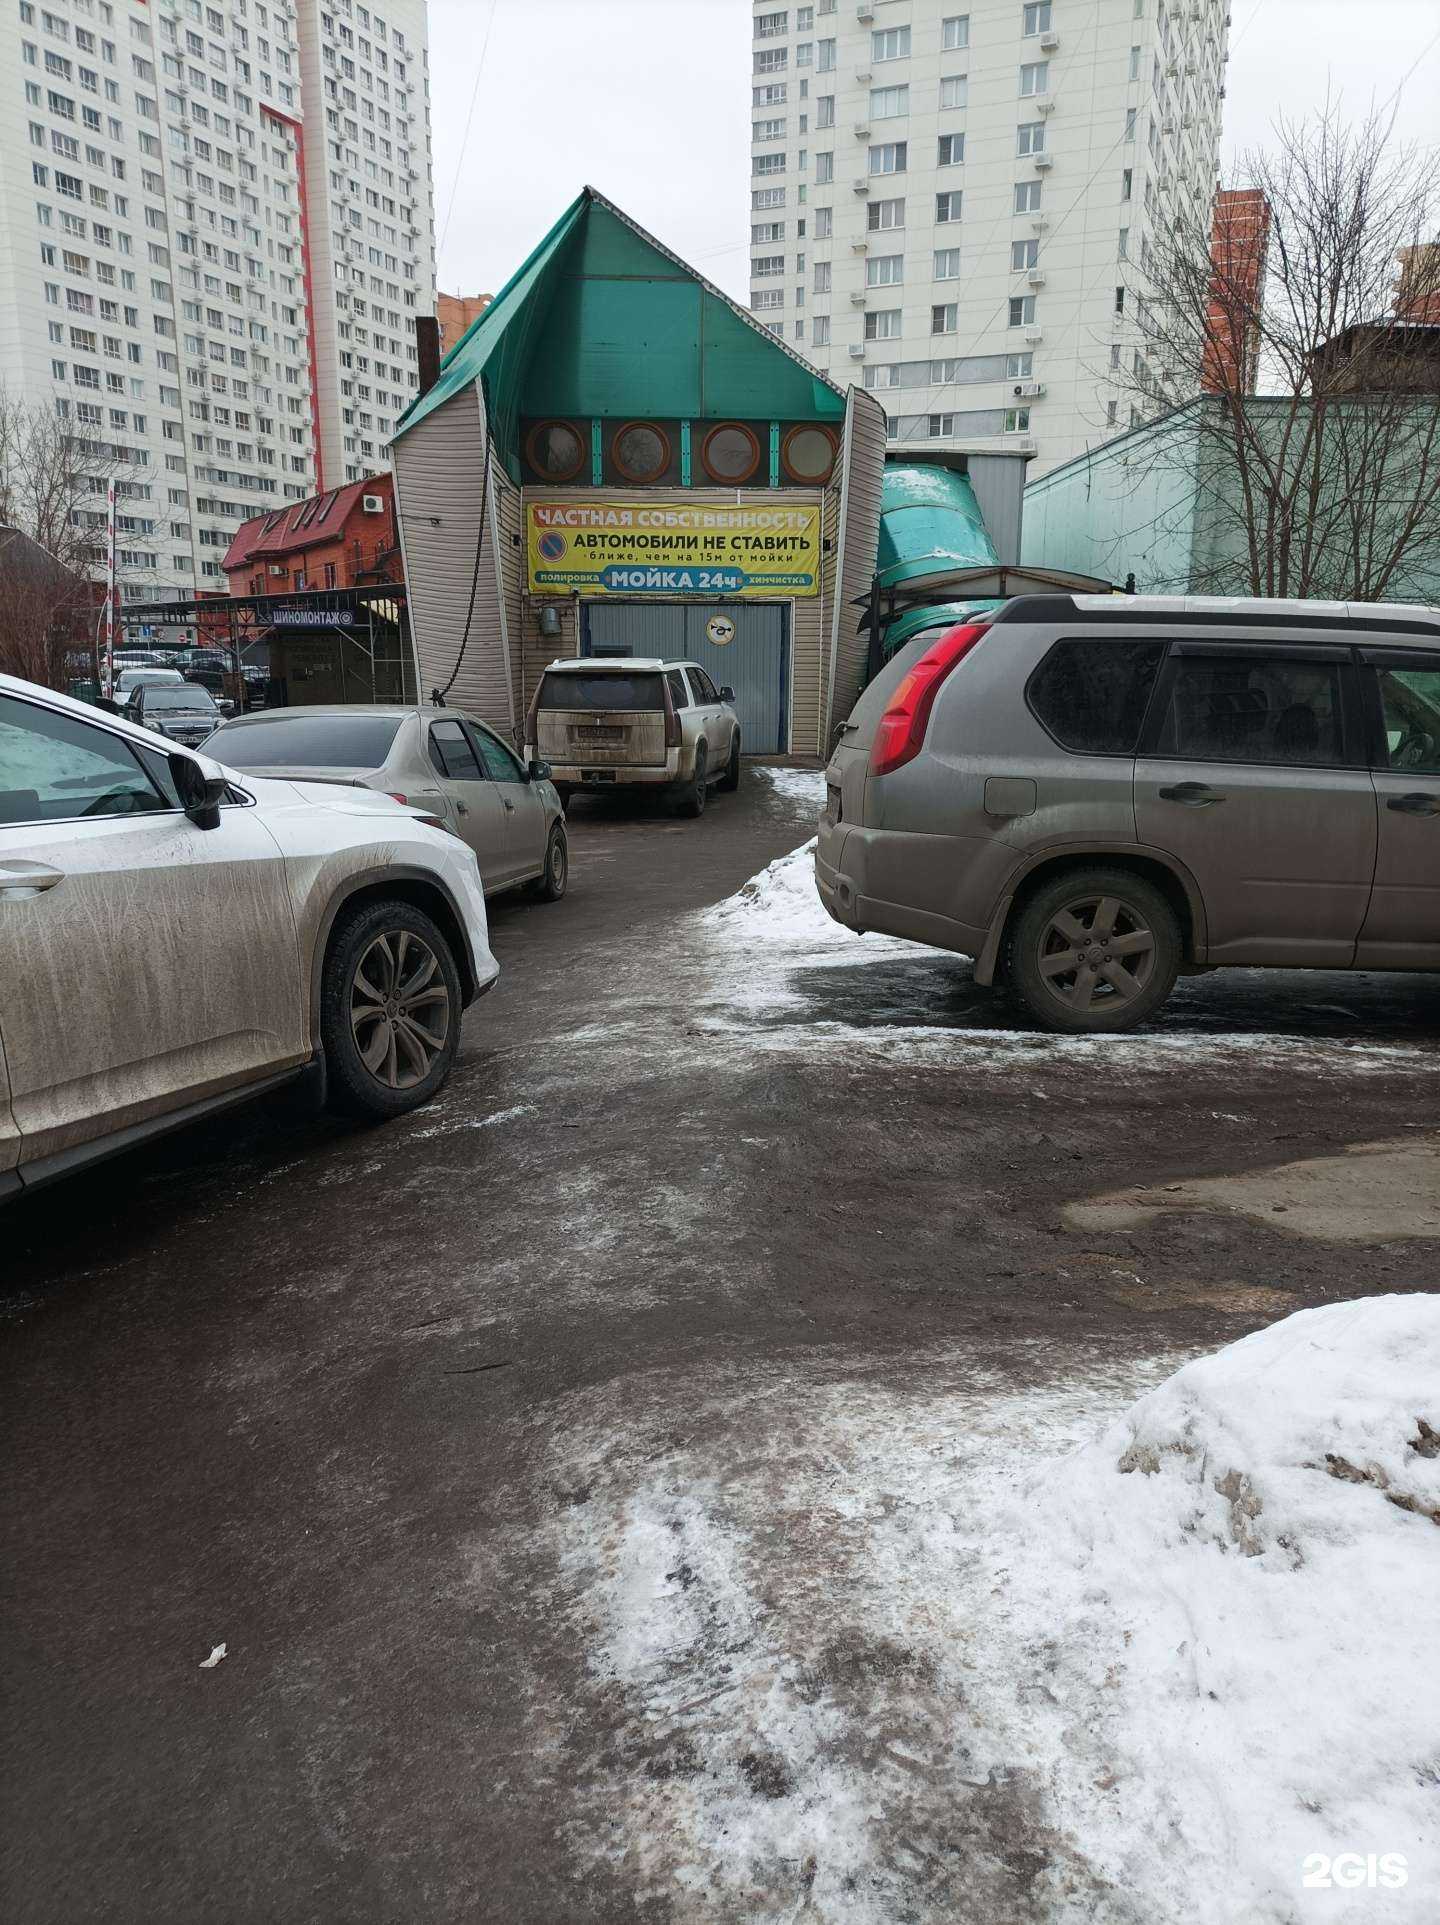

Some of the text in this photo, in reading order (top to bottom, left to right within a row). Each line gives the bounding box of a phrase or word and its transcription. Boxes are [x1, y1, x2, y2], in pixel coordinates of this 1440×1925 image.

[537, 509, 809, 529] ЧАСТНАЯ СОБСТВЕННОСТЬ
[573, 534, 811, 550] АВТОМОБИЛИ НЕ СТАВИТЬ
[699, 553, 723, 562] 15м
[729, 554, 744, 562] от
[750, 553, 793, 562] мойки
[540, 573, 600, 583] полировка
[611, 567, 737, 588] МОЙКА 24ч
[273, 610, 341, 624] ШИНОМОНТАЖ
